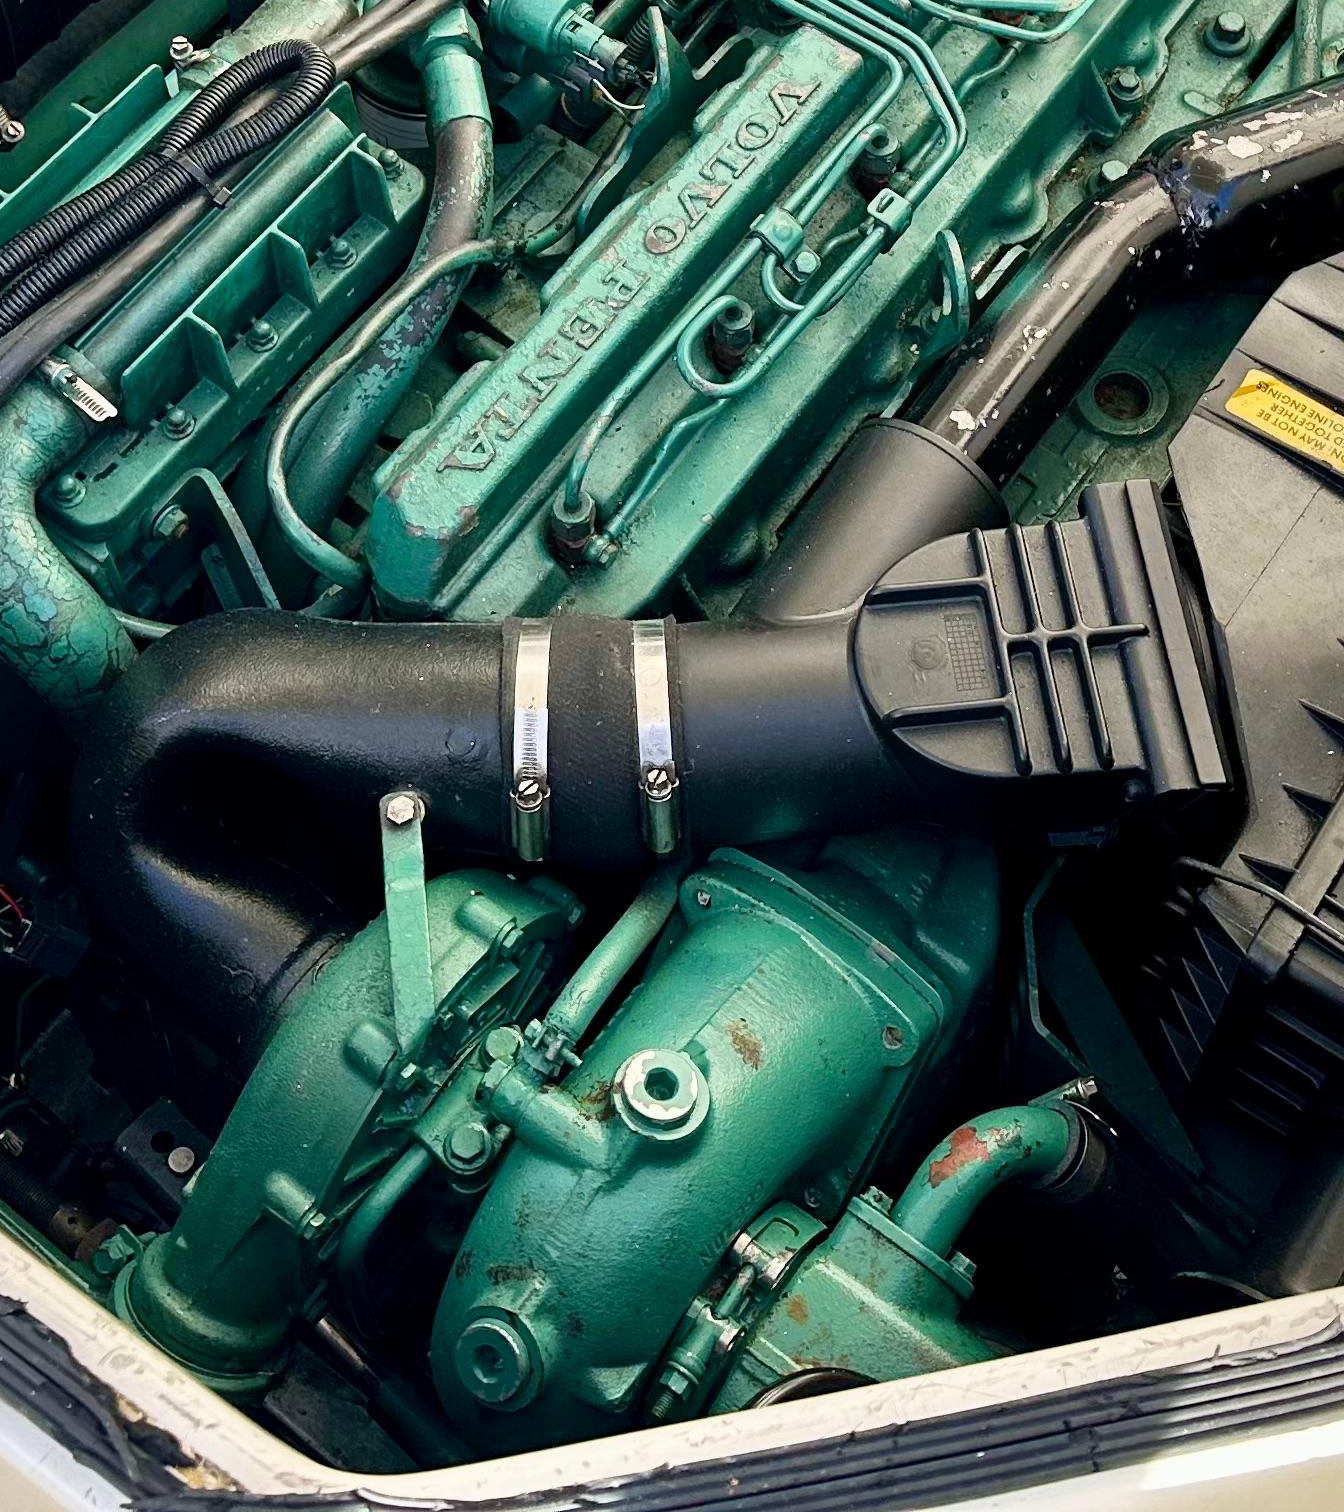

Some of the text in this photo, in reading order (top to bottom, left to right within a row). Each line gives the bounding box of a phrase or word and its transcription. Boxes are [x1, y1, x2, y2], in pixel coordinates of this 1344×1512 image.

[437, 79, 823, 472] VOLVO PENTA
[1257, 380, 1307, 414] ENGINES
[1256, 408, 1273, 421] BE
[1270, 402, 1333, 438] TOGETHER
[1271, 419, 1300, 438] NOT
[1298, 434, 1327, 453] MAY
